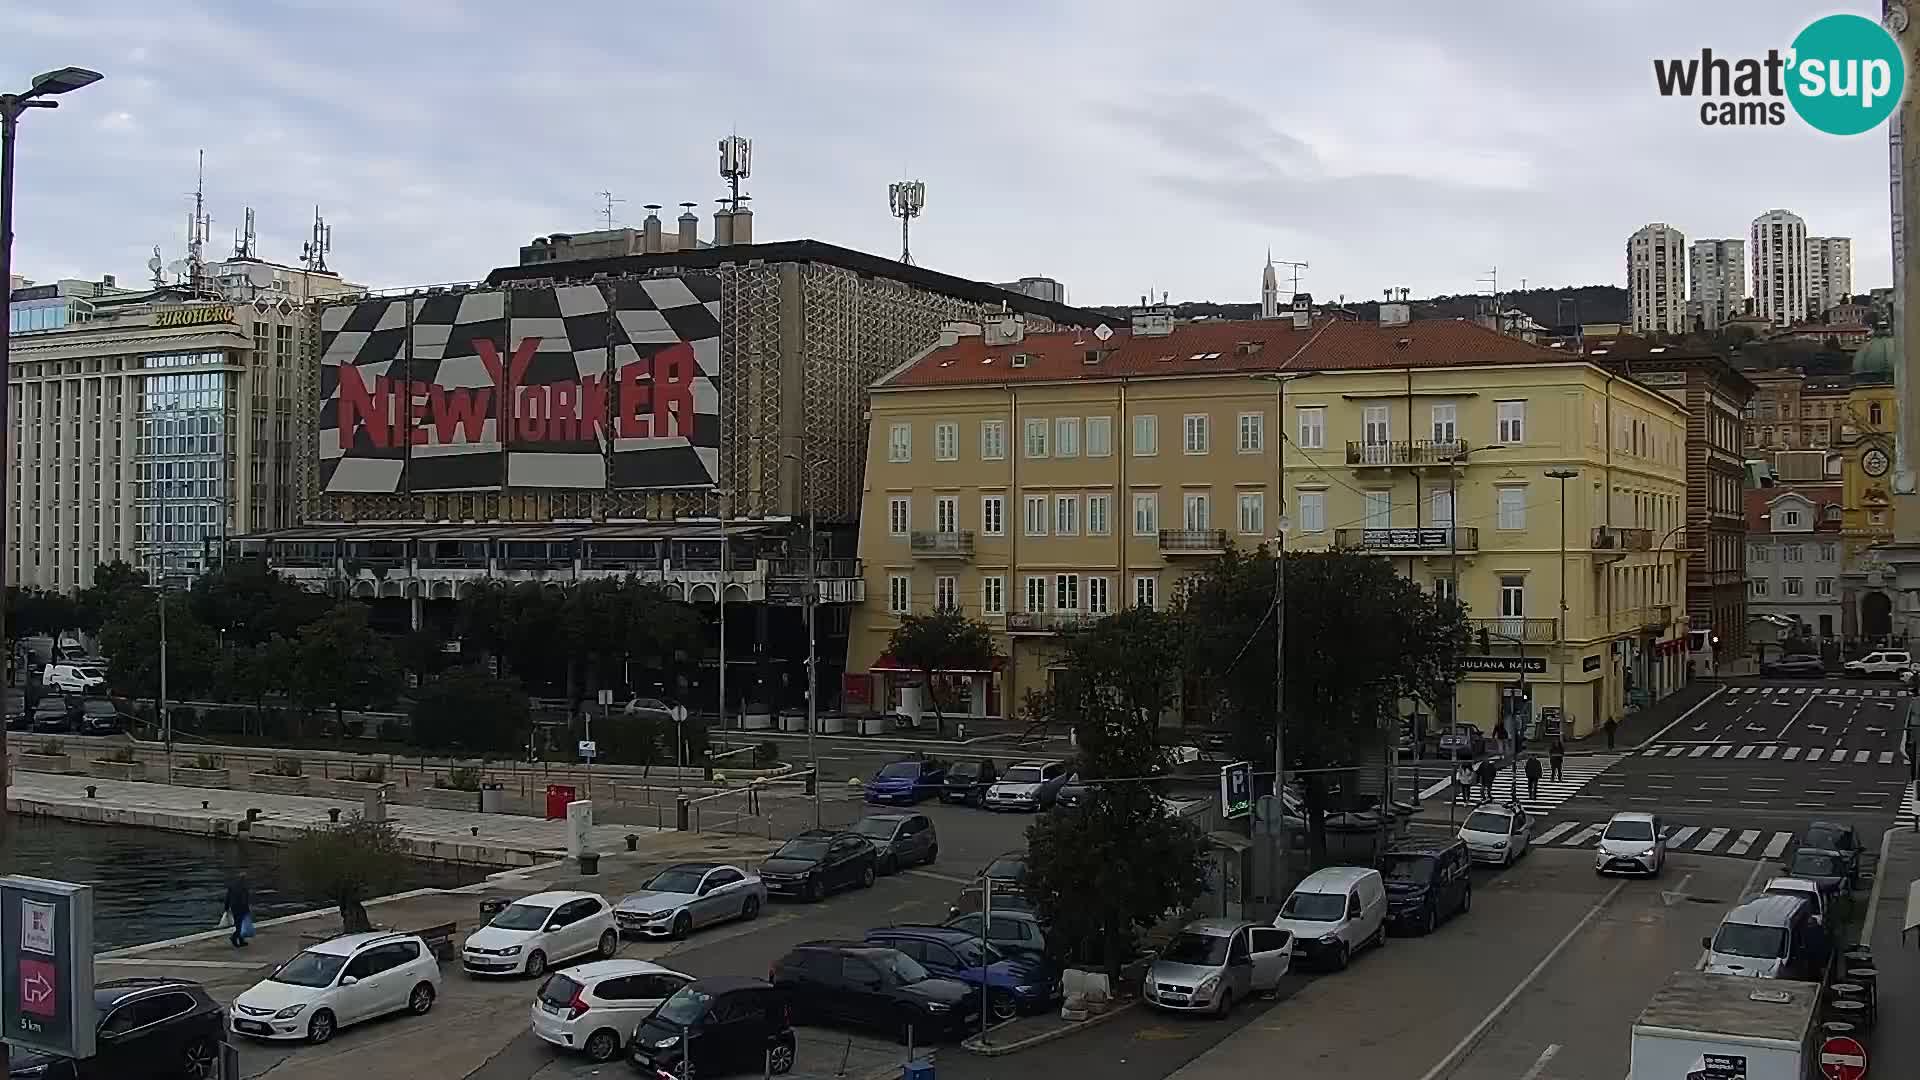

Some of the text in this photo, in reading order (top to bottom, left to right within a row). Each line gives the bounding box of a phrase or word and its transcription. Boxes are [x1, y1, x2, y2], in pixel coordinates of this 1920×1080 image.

[1460, 660, 1541, 669] JULIANA NAILS
[20, 1017, 41, 1032] 5 km
